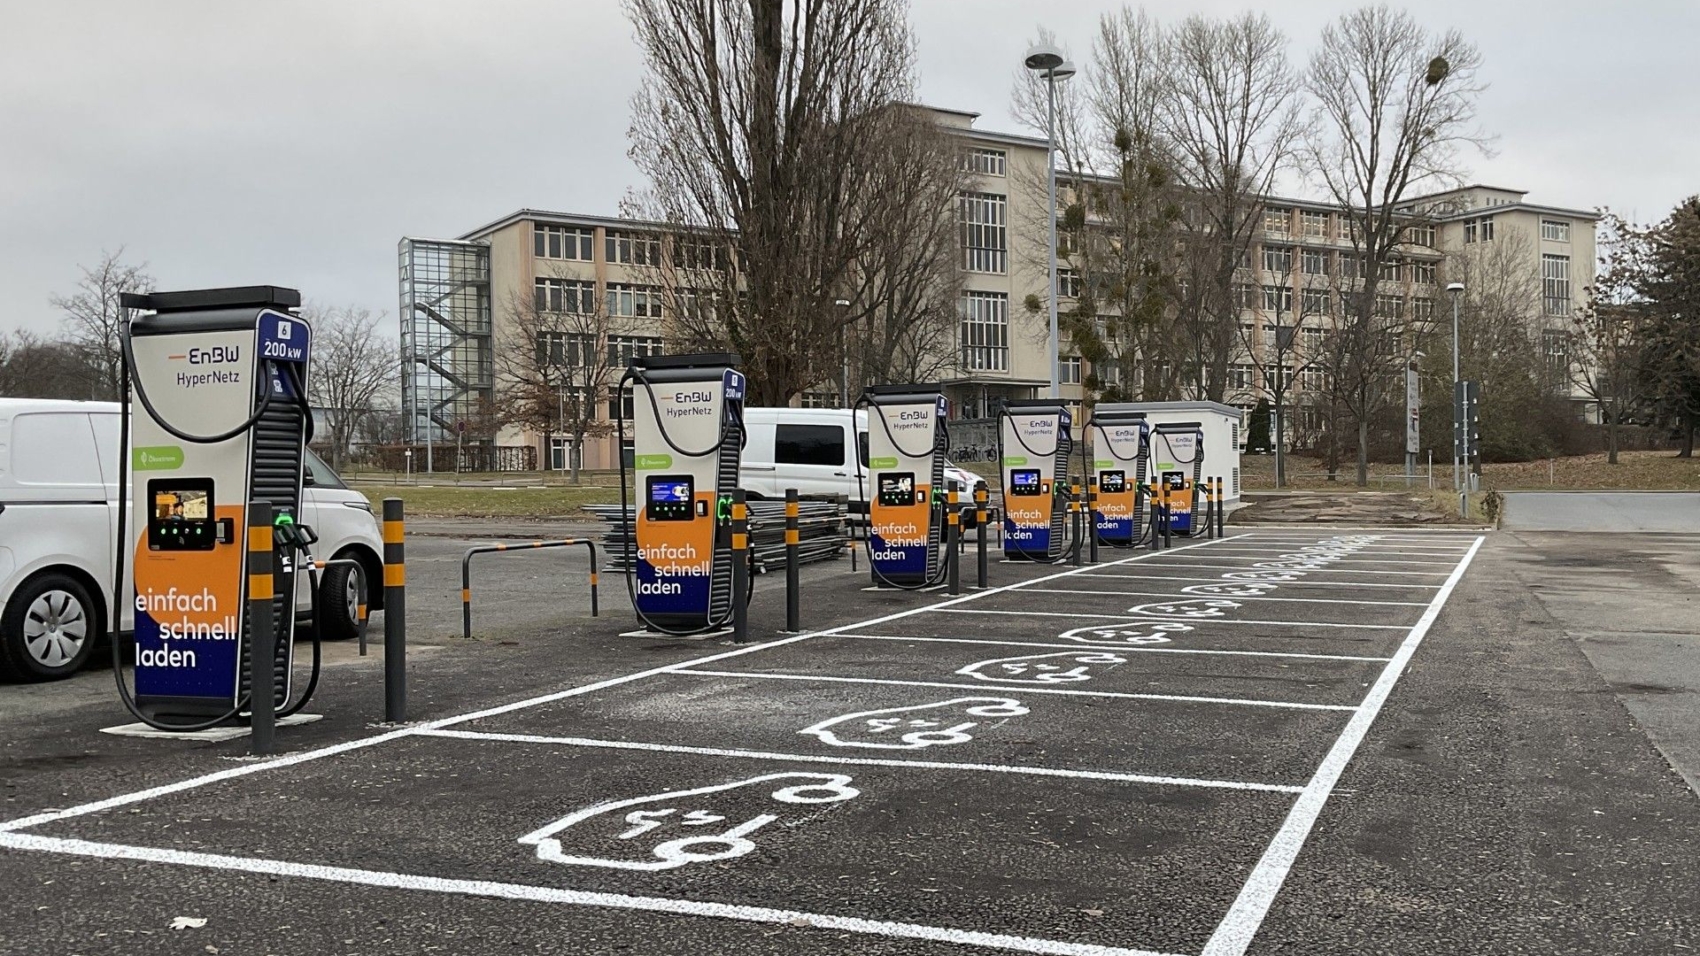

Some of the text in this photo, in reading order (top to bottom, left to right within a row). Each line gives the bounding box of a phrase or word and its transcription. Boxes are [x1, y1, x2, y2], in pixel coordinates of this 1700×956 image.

[281, 324, 288, 336] 6
[188, 345, 240, 365] EnBW
[264, 340, 302, 359] 200 kW
[176, 371, 240, 388] HyperNetz
[675, 391, 712, 404] EnBW
[666, 407, 712, 417] HyperNetz
[900, 410, 929, 420] EnBW
[893, 422, 929, 431] HyperNetz
[1104, 512, 1133, 521] schnell
[1169, 506, 1191, 515] chnell
[871, 522, 917, 535] einfach
[1015, 519, 1050, 529] schnell
[1096, 520, 1119, 529] aden
[884, 535, 927, 548] schnell
[636, 543, 696, 560] einfach
[871, 548, 906, 560] laden
[654, 561, 710, 577] schnell
[637, 579, 681, 595] laden
[134, 587, 217, 612] einfach
[158, 615, 236, 640] schnell
[135, 643, 196, 667] laden
